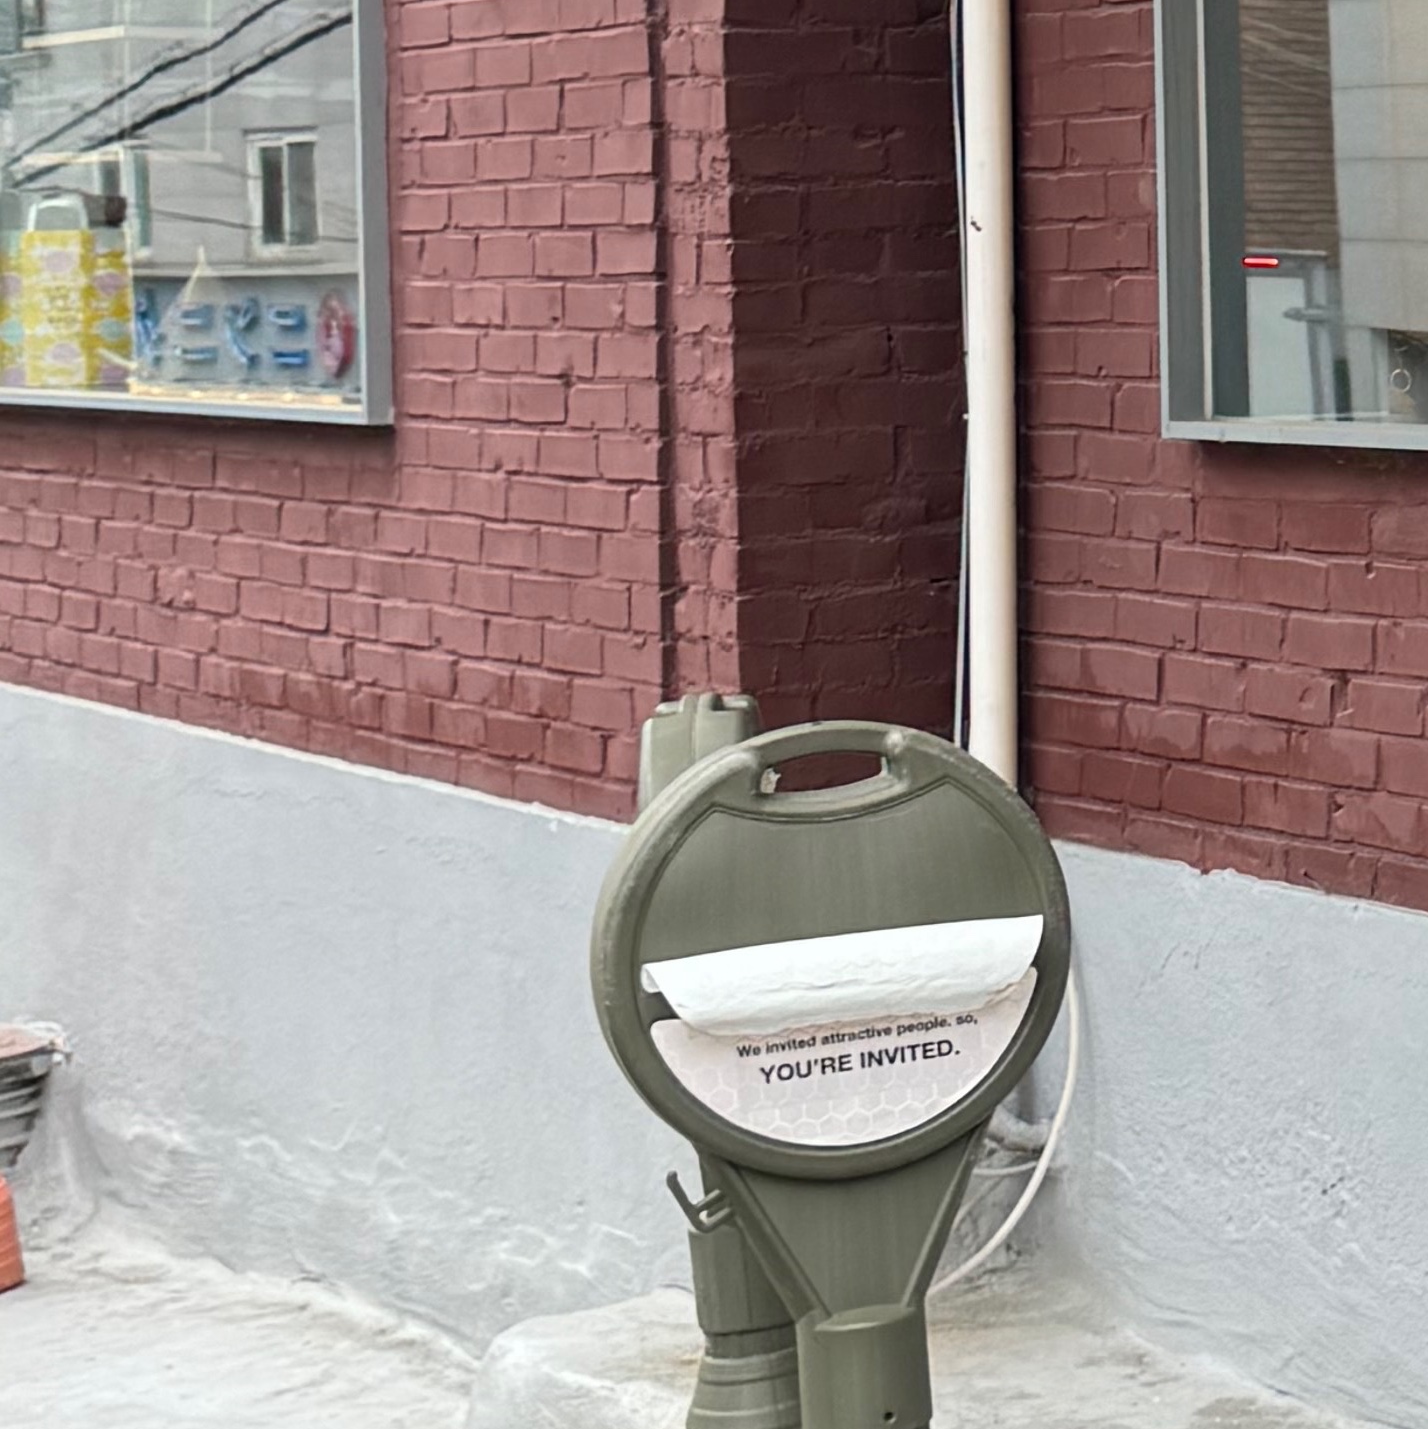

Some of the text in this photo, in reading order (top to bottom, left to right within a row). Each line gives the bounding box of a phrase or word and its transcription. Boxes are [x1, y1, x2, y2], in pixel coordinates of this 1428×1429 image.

[737, 1044, 762, 1058] We
[765, 1035, 817, 1055] invited
[821, 1024, 893, 1046] attractive
[760, 1039, 962, 1084] YOU'RE INVITED.
